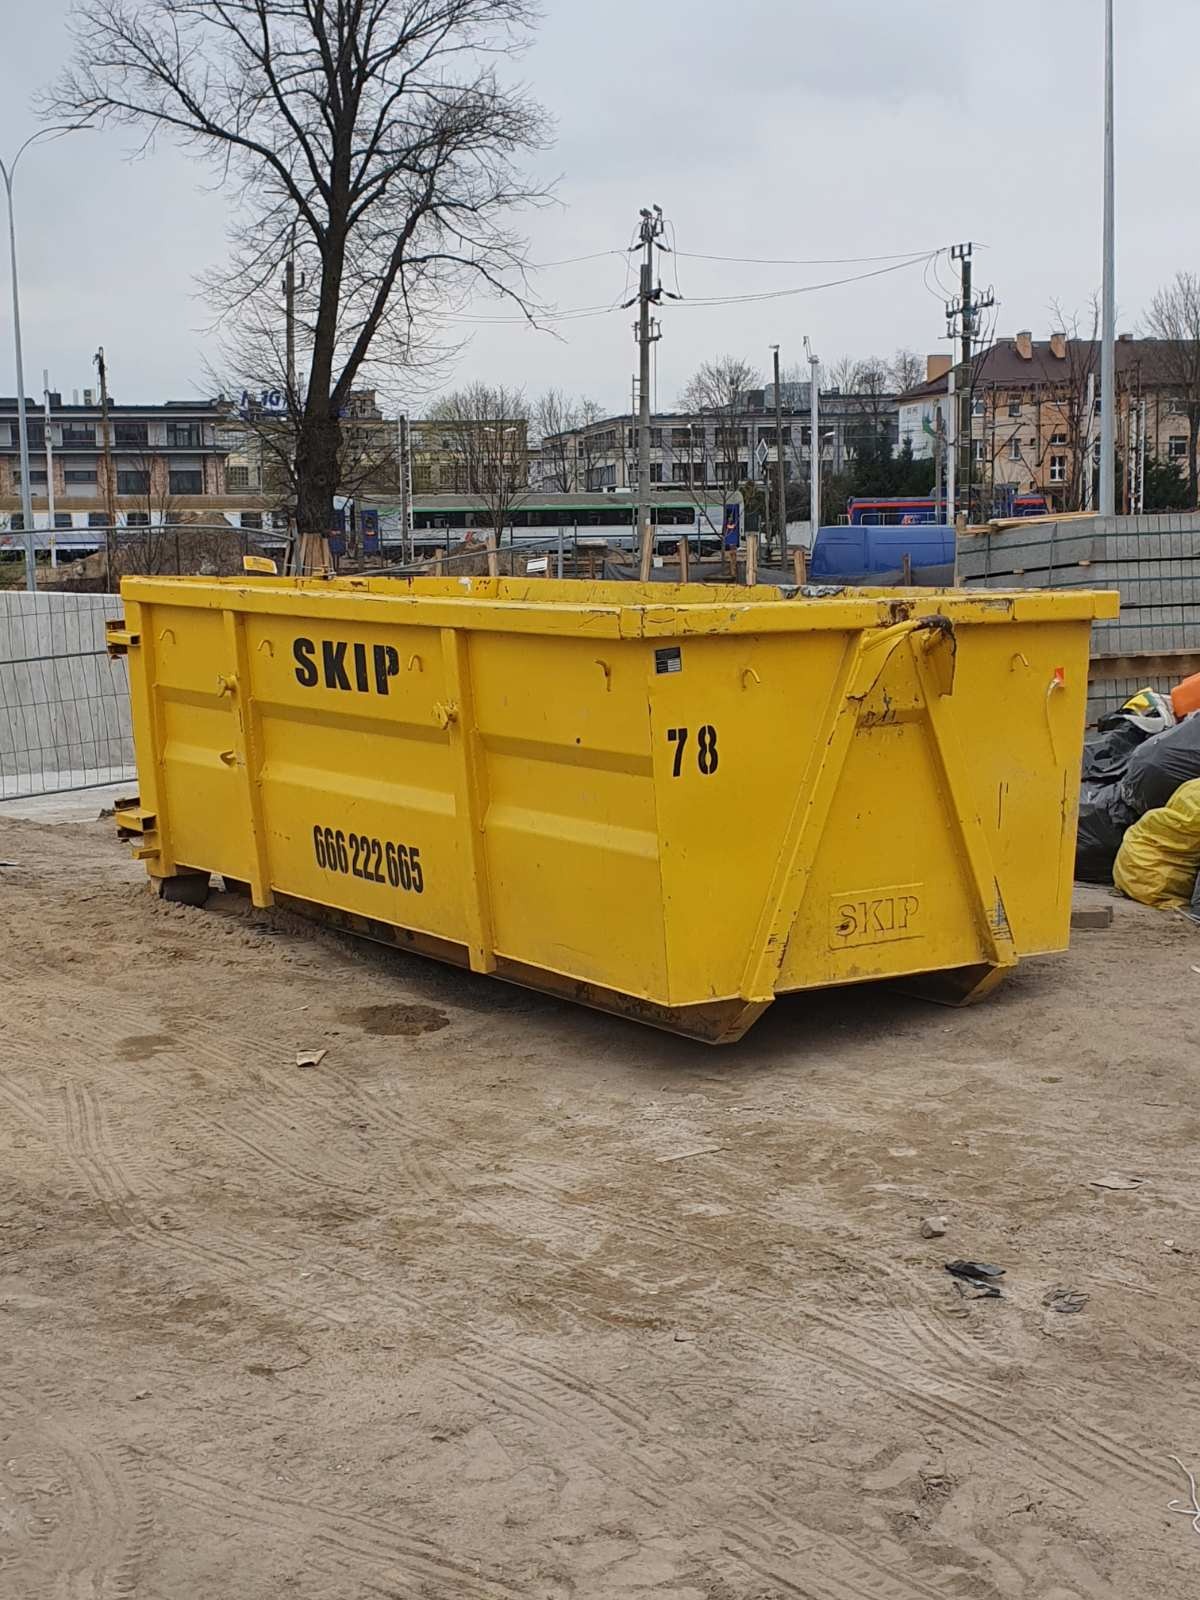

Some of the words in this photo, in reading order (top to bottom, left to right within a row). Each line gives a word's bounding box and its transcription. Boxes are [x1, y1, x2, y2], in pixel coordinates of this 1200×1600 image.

[293, 637, 399, 695] SKIP
[667, 725, 718, 777] 78
[836, 895, 919, 937] SKIP
